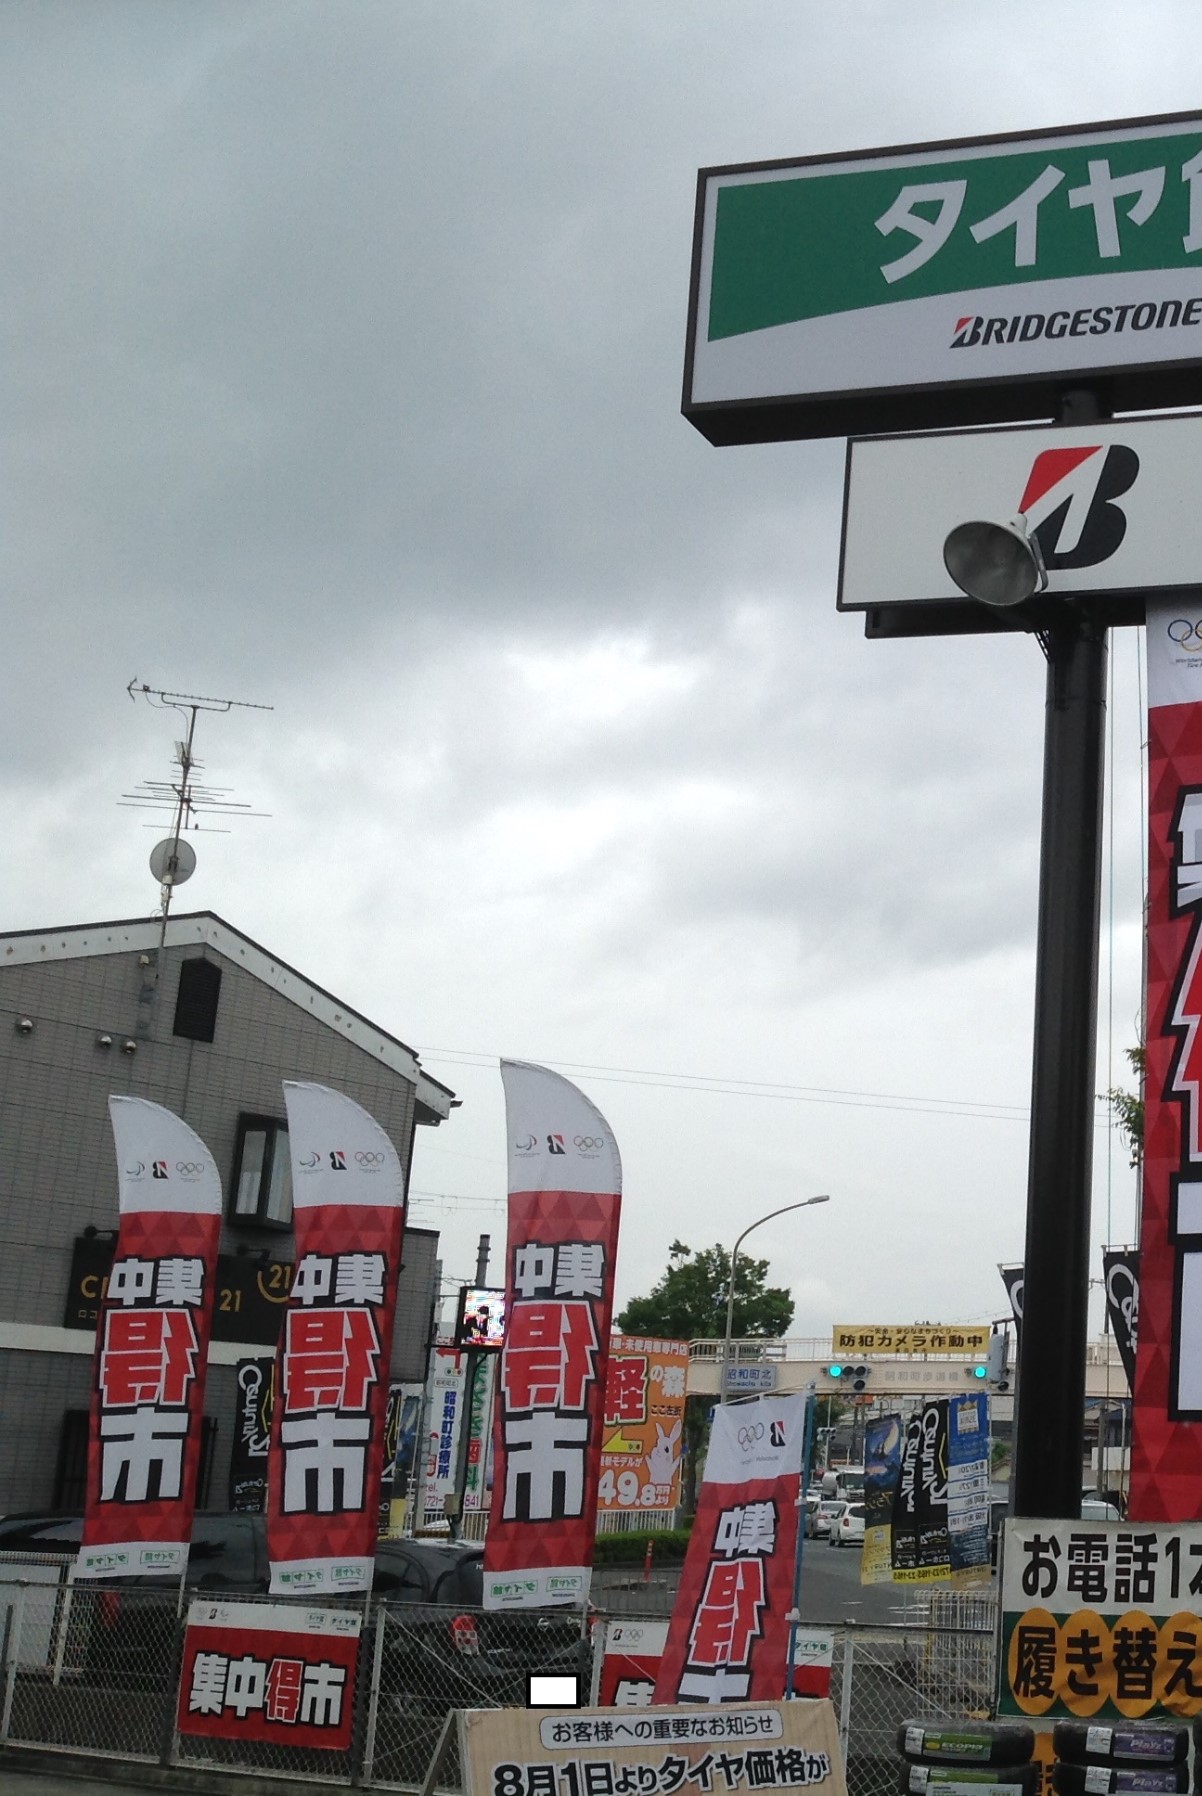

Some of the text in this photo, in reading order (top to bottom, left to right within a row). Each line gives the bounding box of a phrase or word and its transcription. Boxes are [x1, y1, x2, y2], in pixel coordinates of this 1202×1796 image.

[268, 1264, 291, 1290] 21
[219, 1289, 242, 1312] 21
[839, 1334, 984, 1348] 防犯カメラ作動中
[437, 1390, 457, 1479] 昭和町診療所
[189, 1653, 345, 1725] 集中得市
[552, 1714, 774, 1743] お客様への重要なお知らせ
[494, 1748, 829, 1796] 8月1日よりタイヤ価格が
